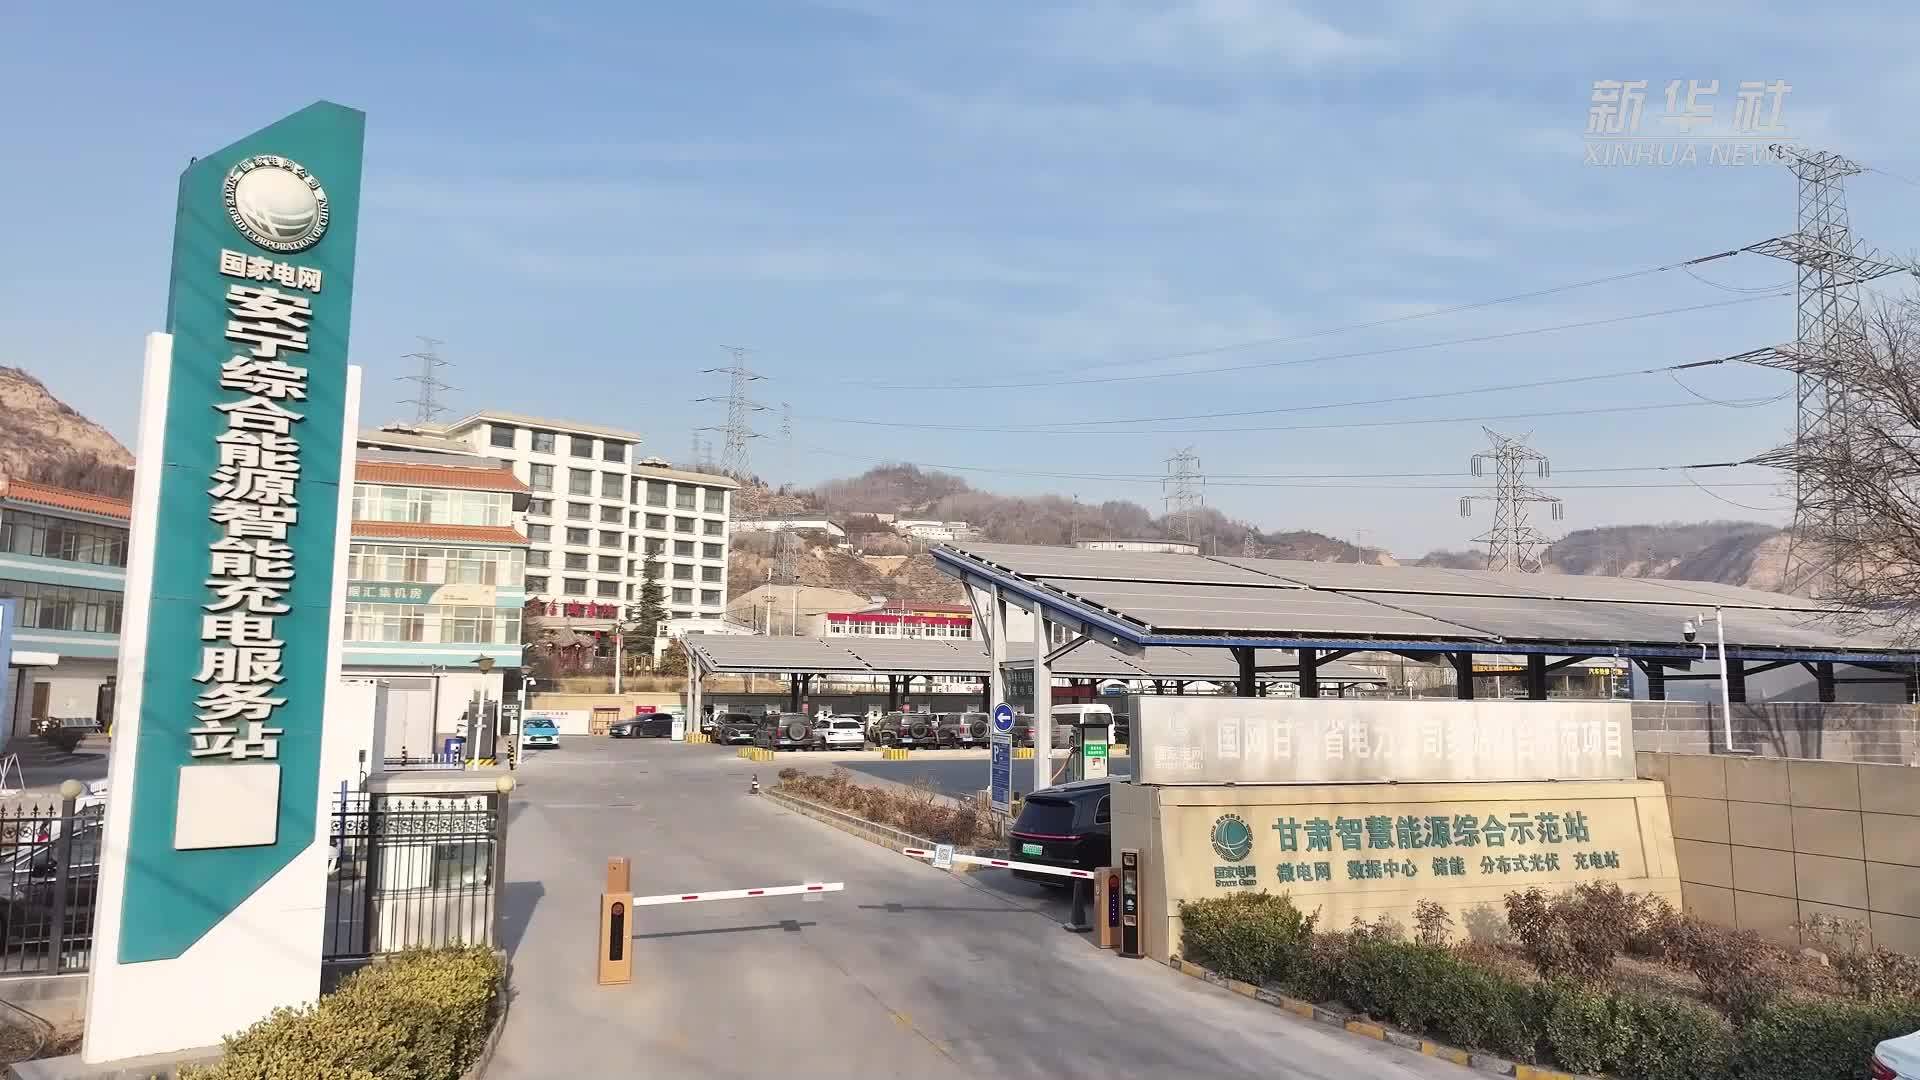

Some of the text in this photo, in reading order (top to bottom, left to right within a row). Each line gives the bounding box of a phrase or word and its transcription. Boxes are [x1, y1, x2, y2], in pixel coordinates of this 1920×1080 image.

[228, 208, 247, 231] GRID
[246, 229, 317, 251] CORPORATION
[220, 249, 322, 293] 国家电网
[189, 284, 312, 760] 安宁综合能源智能充电服务站
[1272, 811, 1590, 852] 甘肃智慧能源综合示范站
[1214, 865, 1257, 880] 国家电网
[1277, 850, 1620, 883] 微电网 数据中心 储能 分布式光伏 充电站
